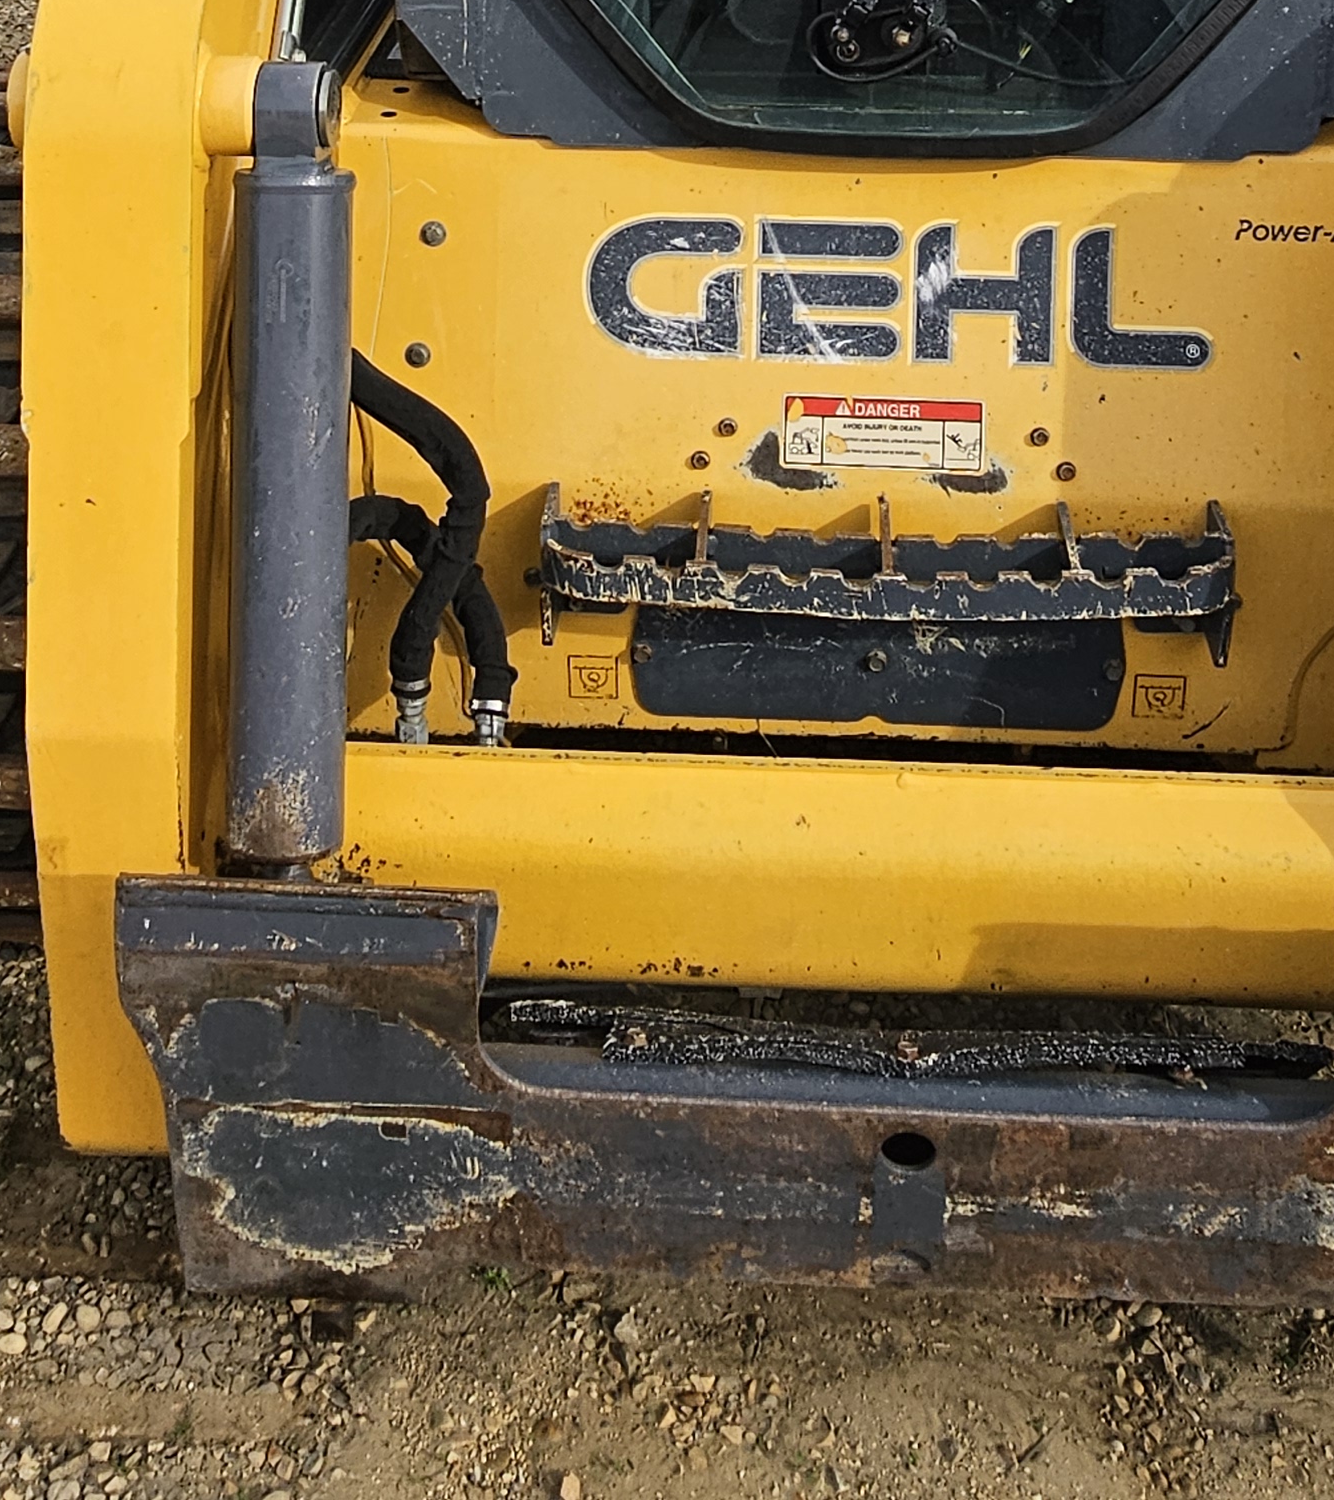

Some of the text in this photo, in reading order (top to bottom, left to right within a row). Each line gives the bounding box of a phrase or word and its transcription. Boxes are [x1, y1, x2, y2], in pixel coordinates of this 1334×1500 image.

[586, 212, 1213, 370] GEHL
[854, 402, 921, 418] DANGER
[899, 424, 922, 432] DEATH
